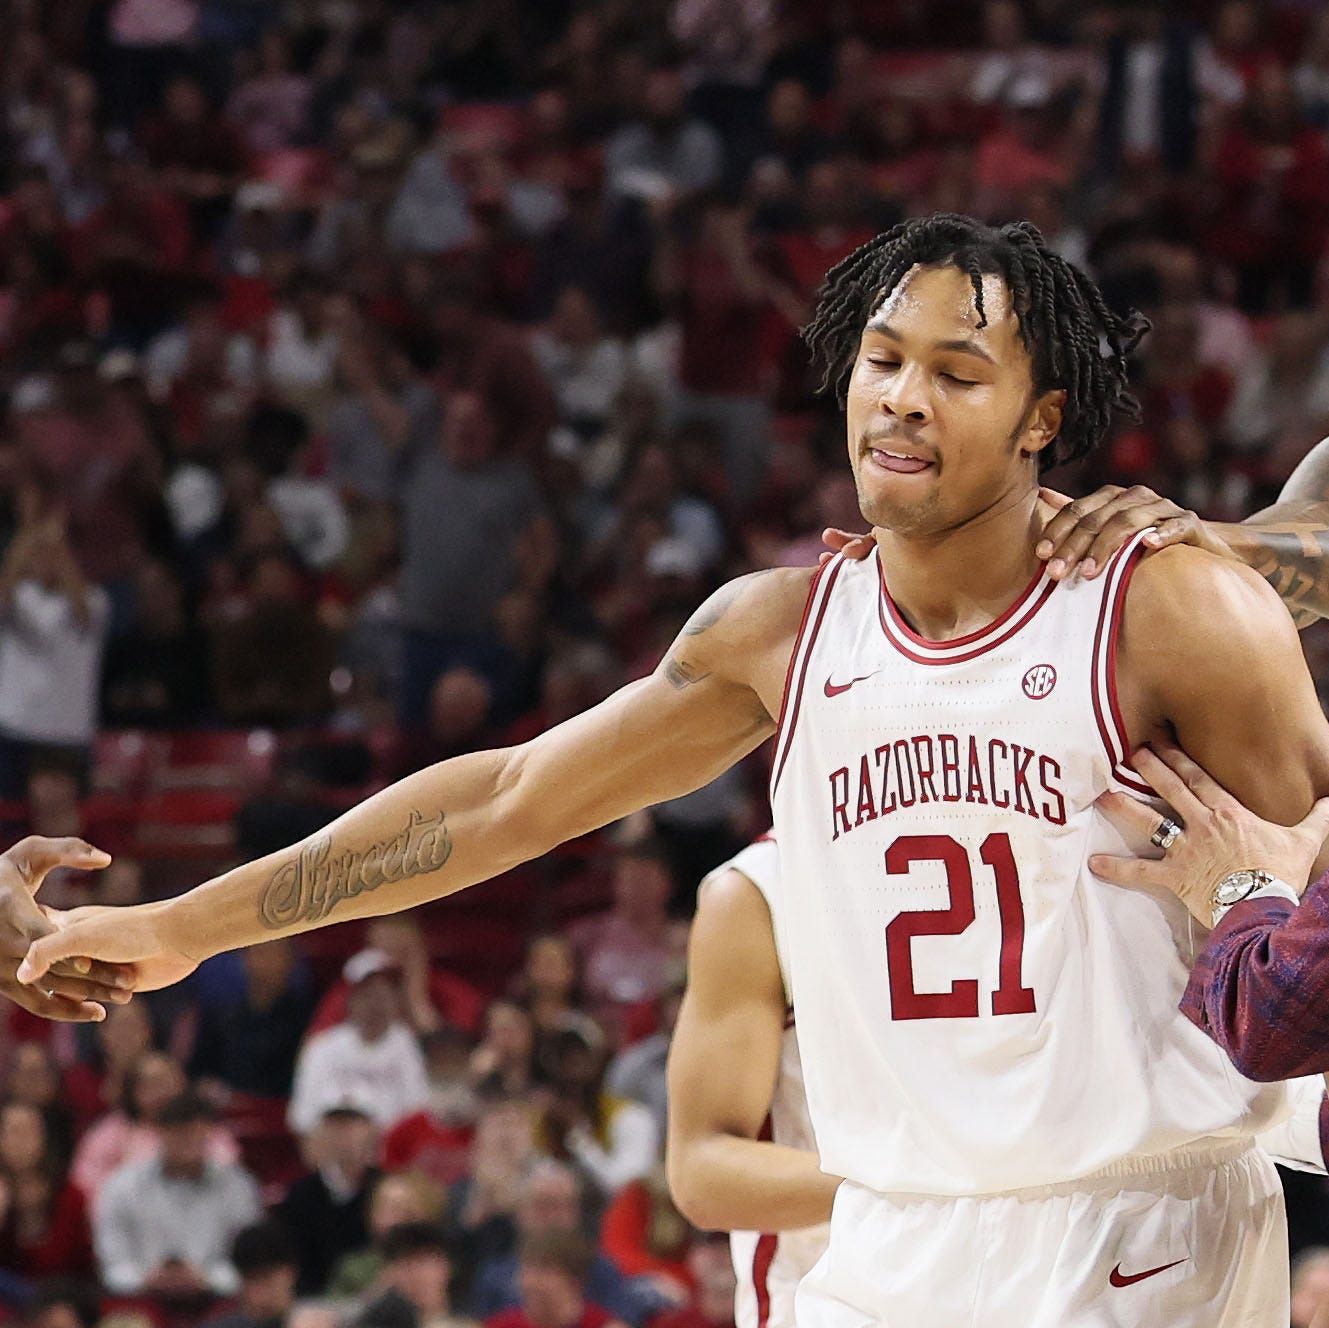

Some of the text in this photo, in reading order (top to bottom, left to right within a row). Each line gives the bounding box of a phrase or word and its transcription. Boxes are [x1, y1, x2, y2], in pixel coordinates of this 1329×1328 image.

[1023, 665, 1056, 698] SEC
[829, 735, 1067, 841] RAZORBACKS
[885, 832, 1037, 1020] 21
